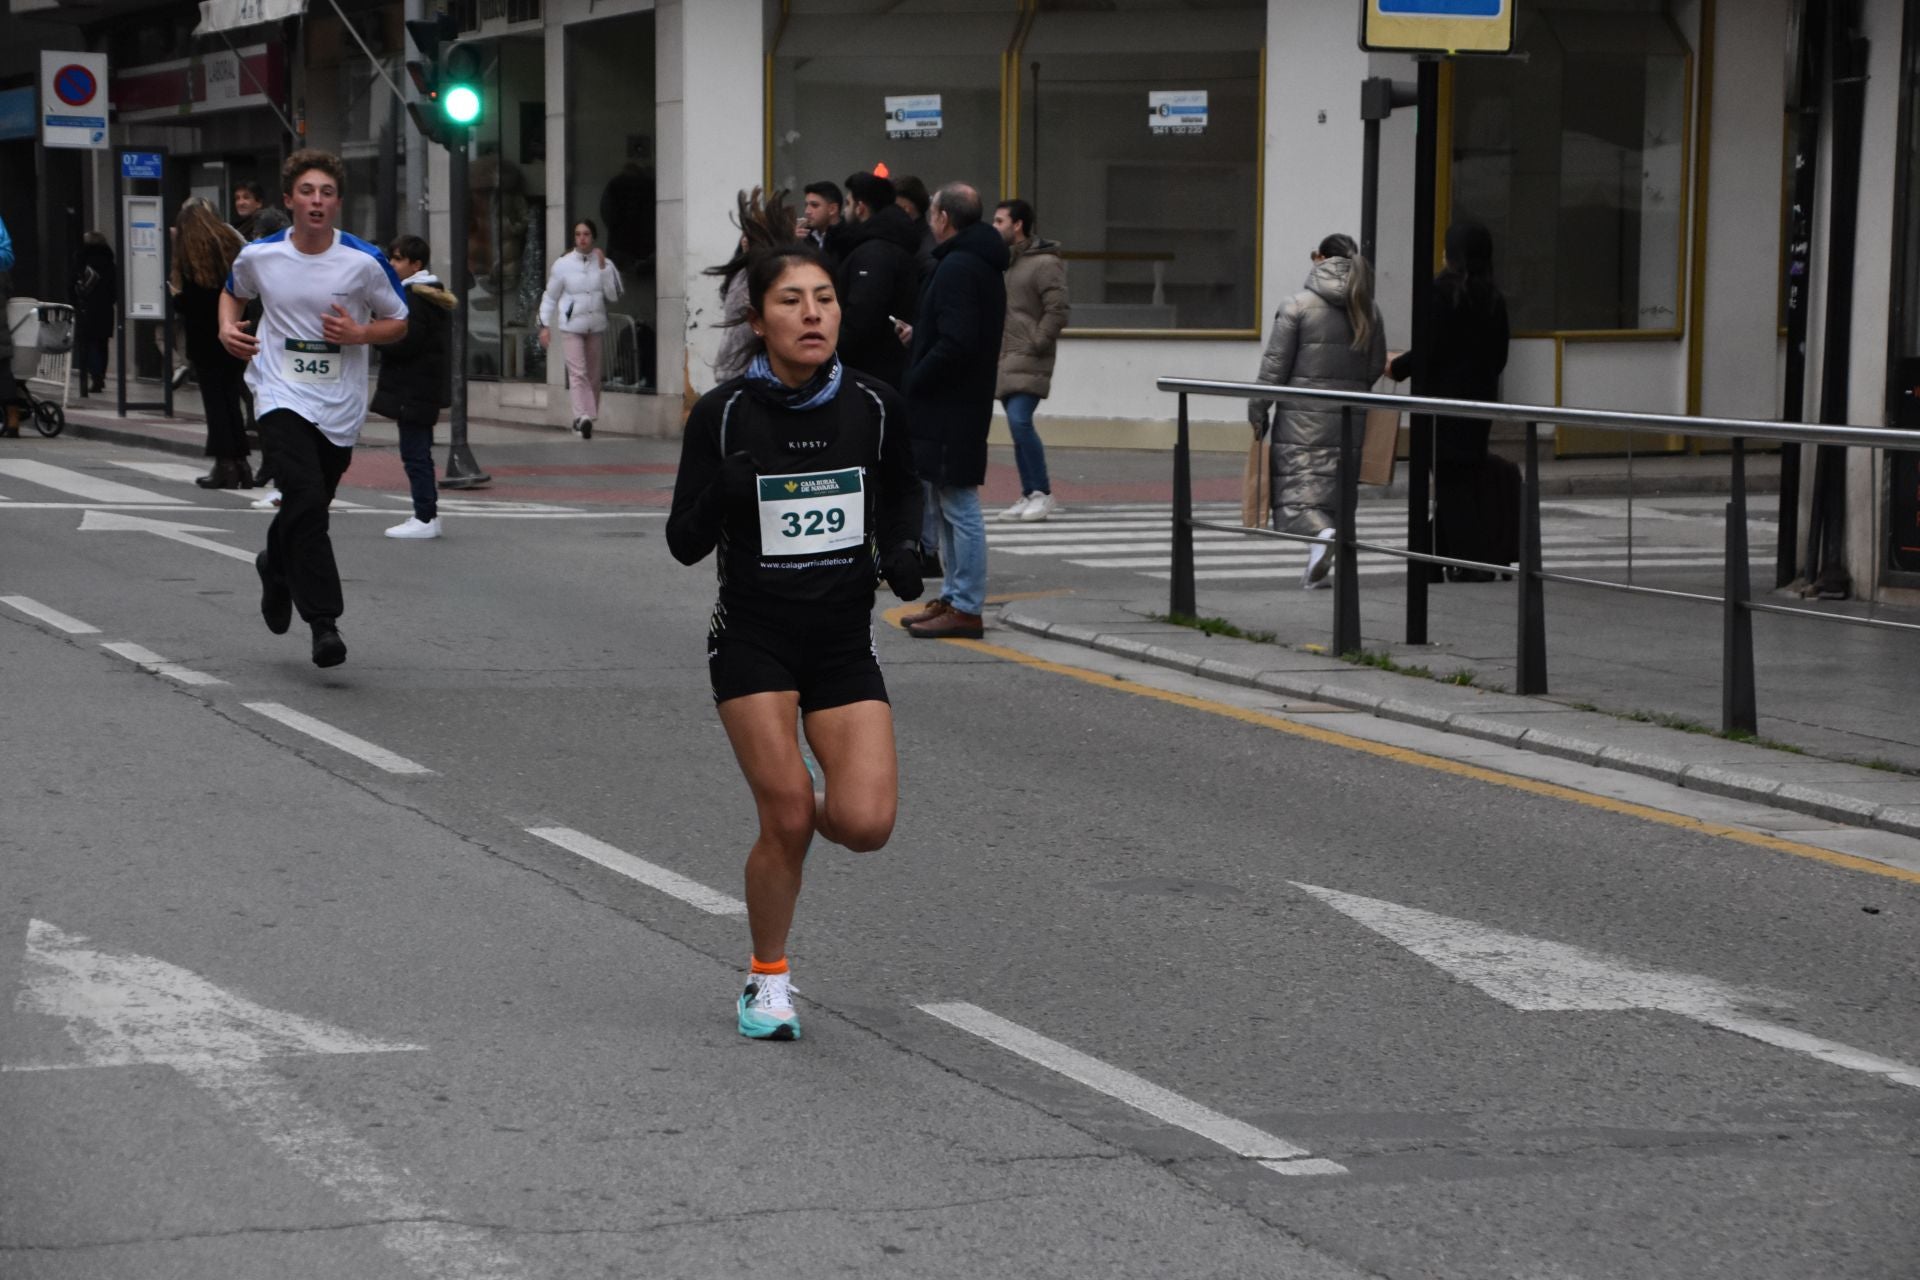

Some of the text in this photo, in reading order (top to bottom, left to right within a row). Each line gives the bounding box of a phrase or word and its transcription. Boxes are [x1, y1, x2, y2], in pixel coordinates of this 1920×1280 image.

[123, 154, 138, 165] 07
[294, 358, 329, 374] 345
[816, 478, 836, 486] RURAL
[811, 484, 840, 492] NAVARRA
[781, 507, 845, 538] 329
